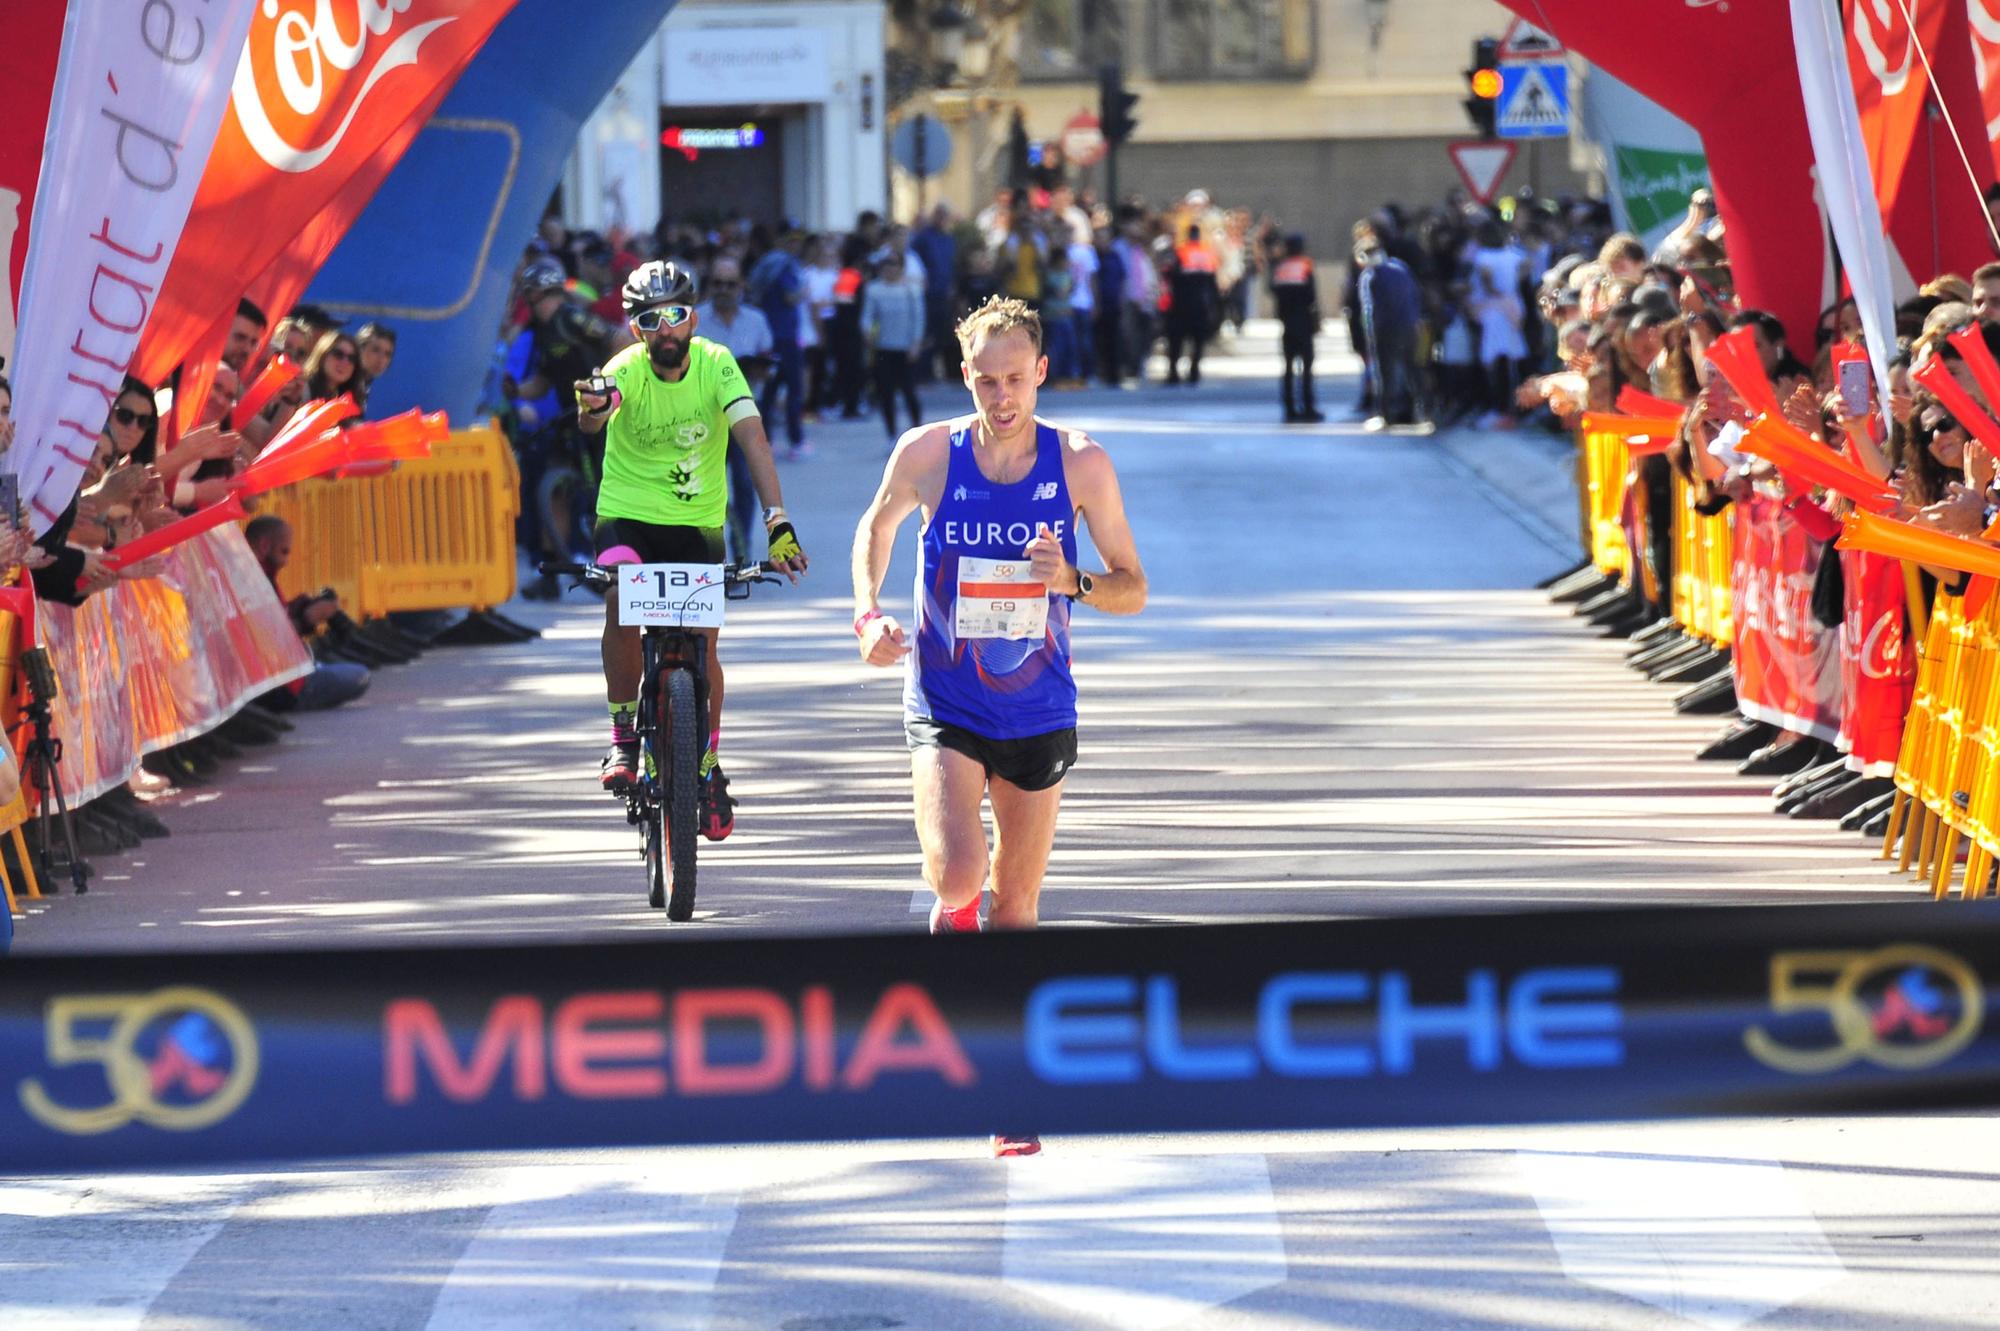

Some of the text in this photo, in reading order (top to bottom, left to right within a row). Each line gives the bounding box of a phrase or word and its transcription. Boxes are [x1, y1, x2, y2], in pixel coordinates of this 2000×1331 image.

[1032, 482, 1058, 501] NB
[630, 599, 713, 612] POSICIÓN
[991, 601, 1016, 612] 69
[18, 944, 1983, 1134] 50 MEDIA ELCHE 50
